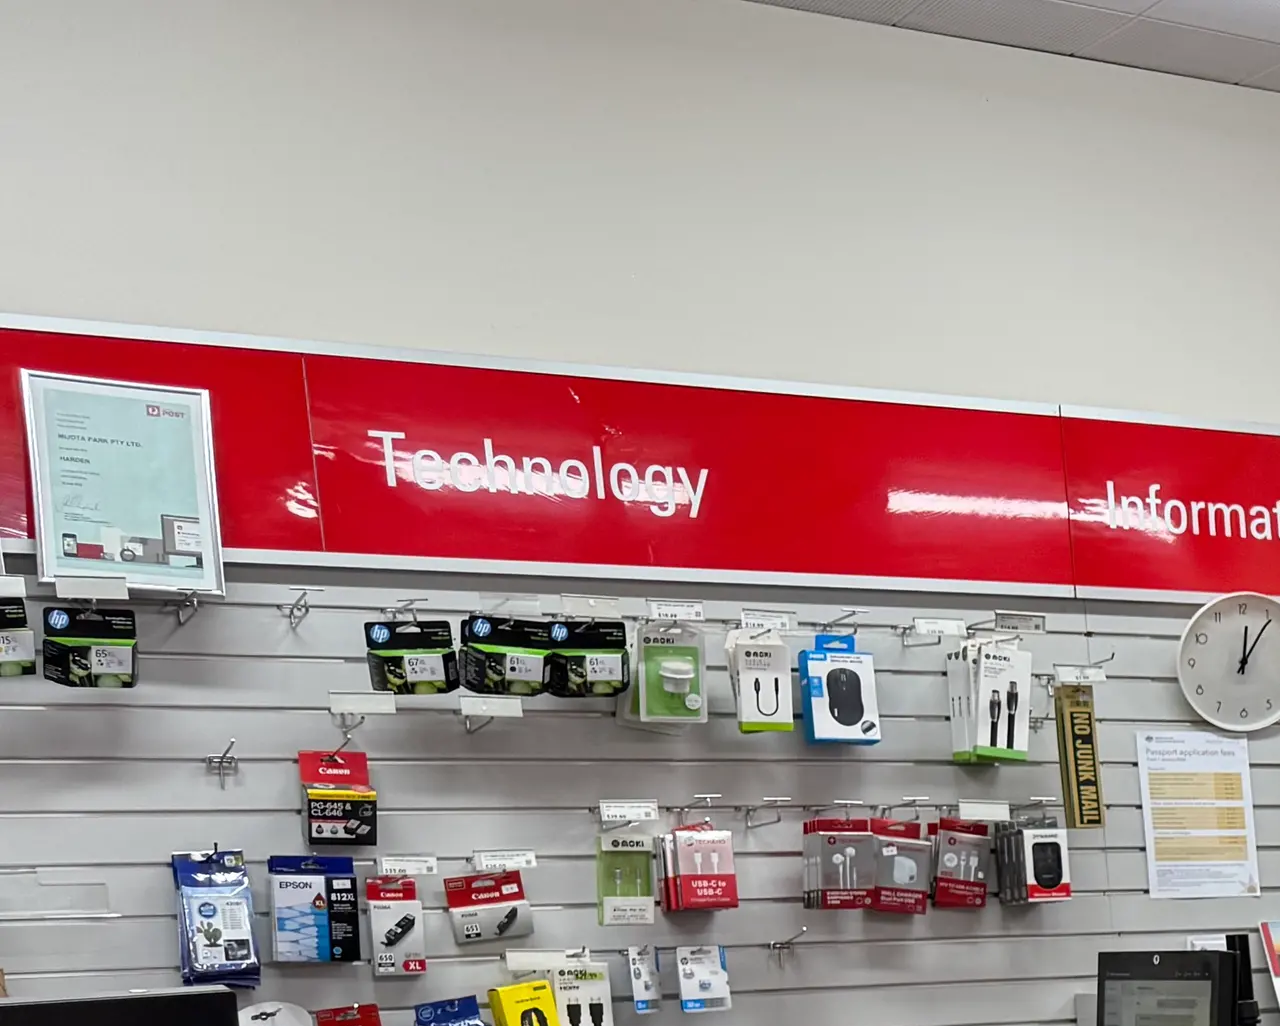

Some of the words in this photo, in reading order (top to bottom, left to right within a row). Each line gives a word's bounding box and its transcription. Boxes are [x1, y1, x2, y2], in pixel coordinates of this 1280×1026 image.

[368, 429, 709, 519] Technology
[1239, 603, 1247, 615] 12
[1266, 609, 1269, 619] 1
[1215, 612, 1221, 624] 11
[1195, 633, 1208, 645] 10
[1188, 658, 1195, 669] 9
[1196, 684, 1204, 695] 8
[1217, 702, 1221, 713] 7
[1266, 699, 1272, 710] 5
[1240, 708, 1248, 718] 6
[1073, 713, 1090, 736] NO
[1076, 739, 1095, 782] JUNK
[319, 767, 350, 775] Canon
[1078, 786, 1099, 824] MAIL
[279, 881, 312, 889] EPSON
[691, 880, 715, 888] USB-C
[379, 954, 394, 962] 650
[408, 961, 422, 970] XL
